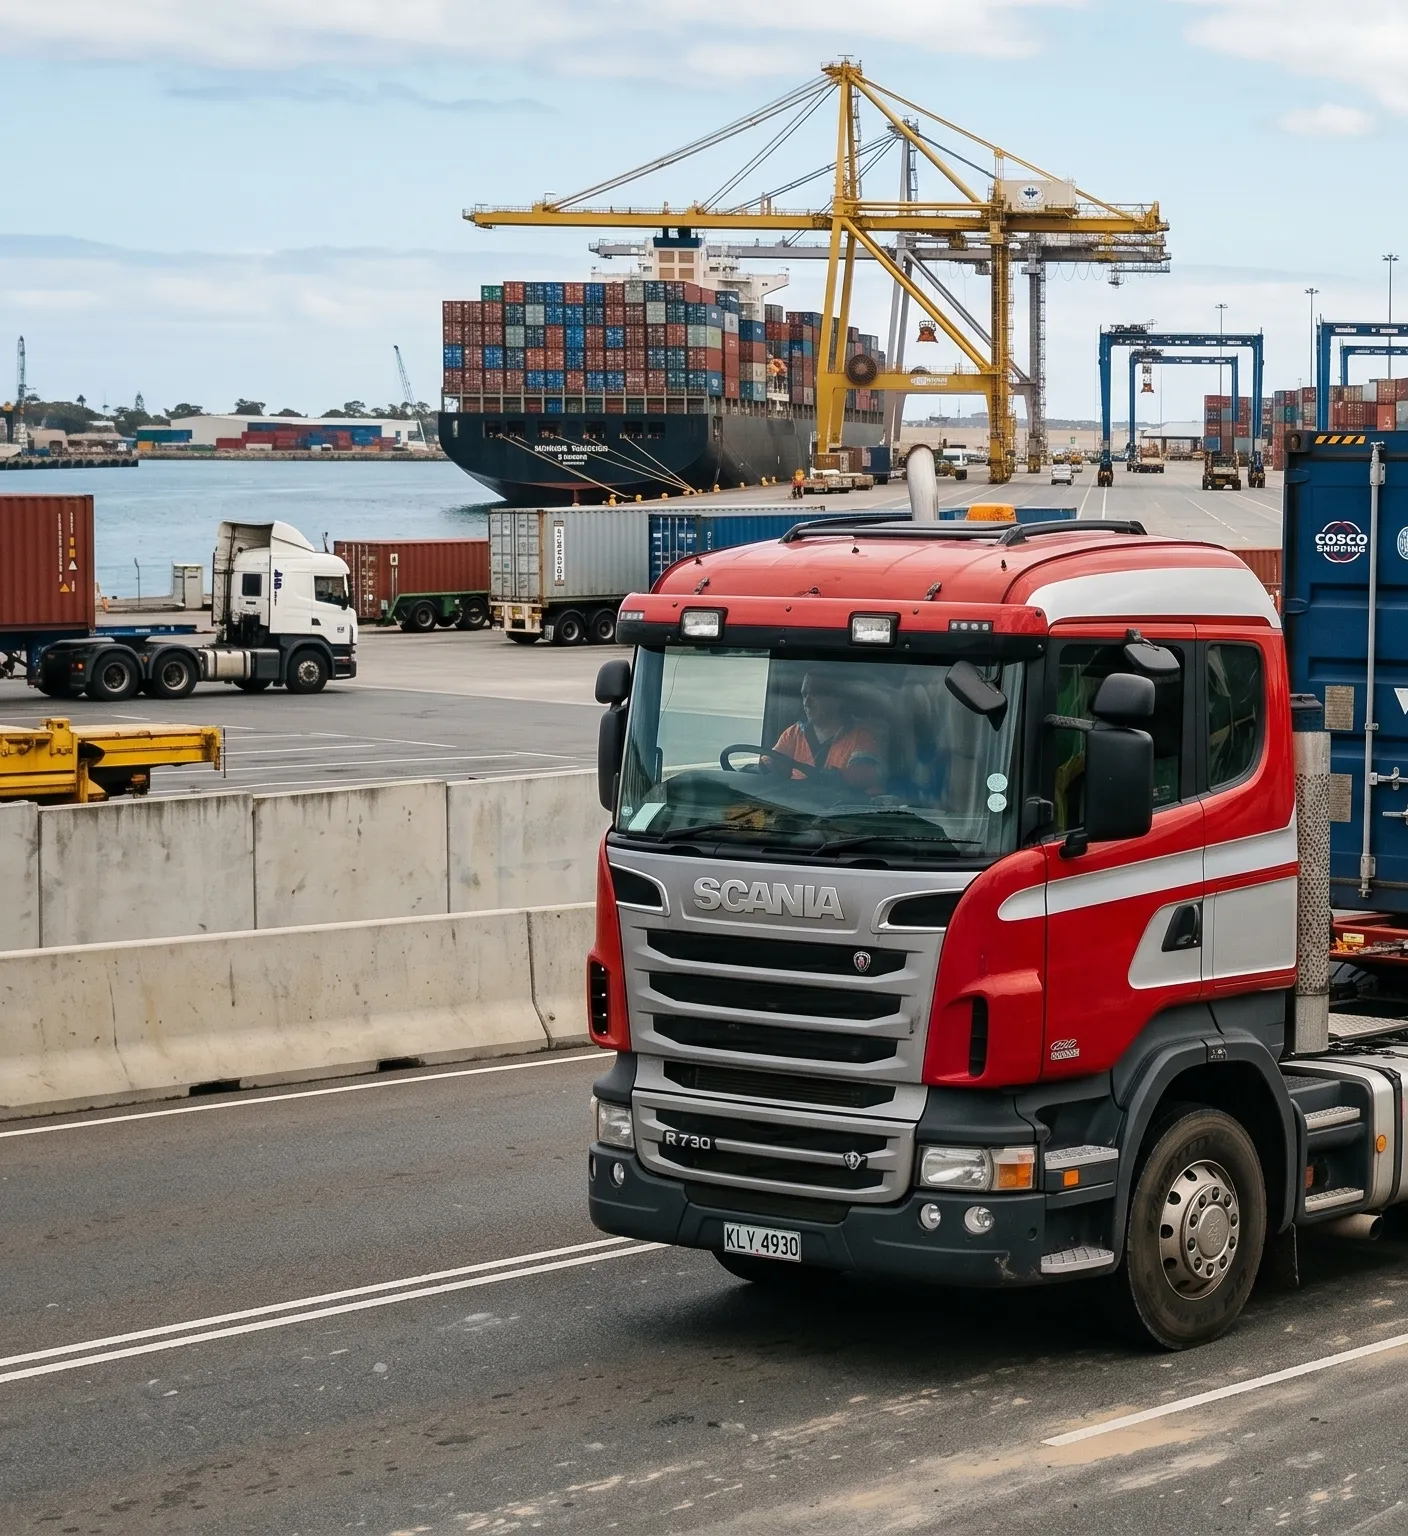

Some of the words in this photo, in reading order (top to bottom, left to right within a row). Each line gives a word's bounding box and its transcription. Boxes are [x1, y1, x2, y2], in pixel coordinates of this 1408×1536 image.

[1315, 533, 1368, 545] COSCO
[693, 876, 846, 921] SCANIA
[665, 1131, 677, 1146] R
[679, 1133, 711, 1150] 730
[725, 1227, 755, 1250] KLY
[760, 1232, 799, 1257] 4930
